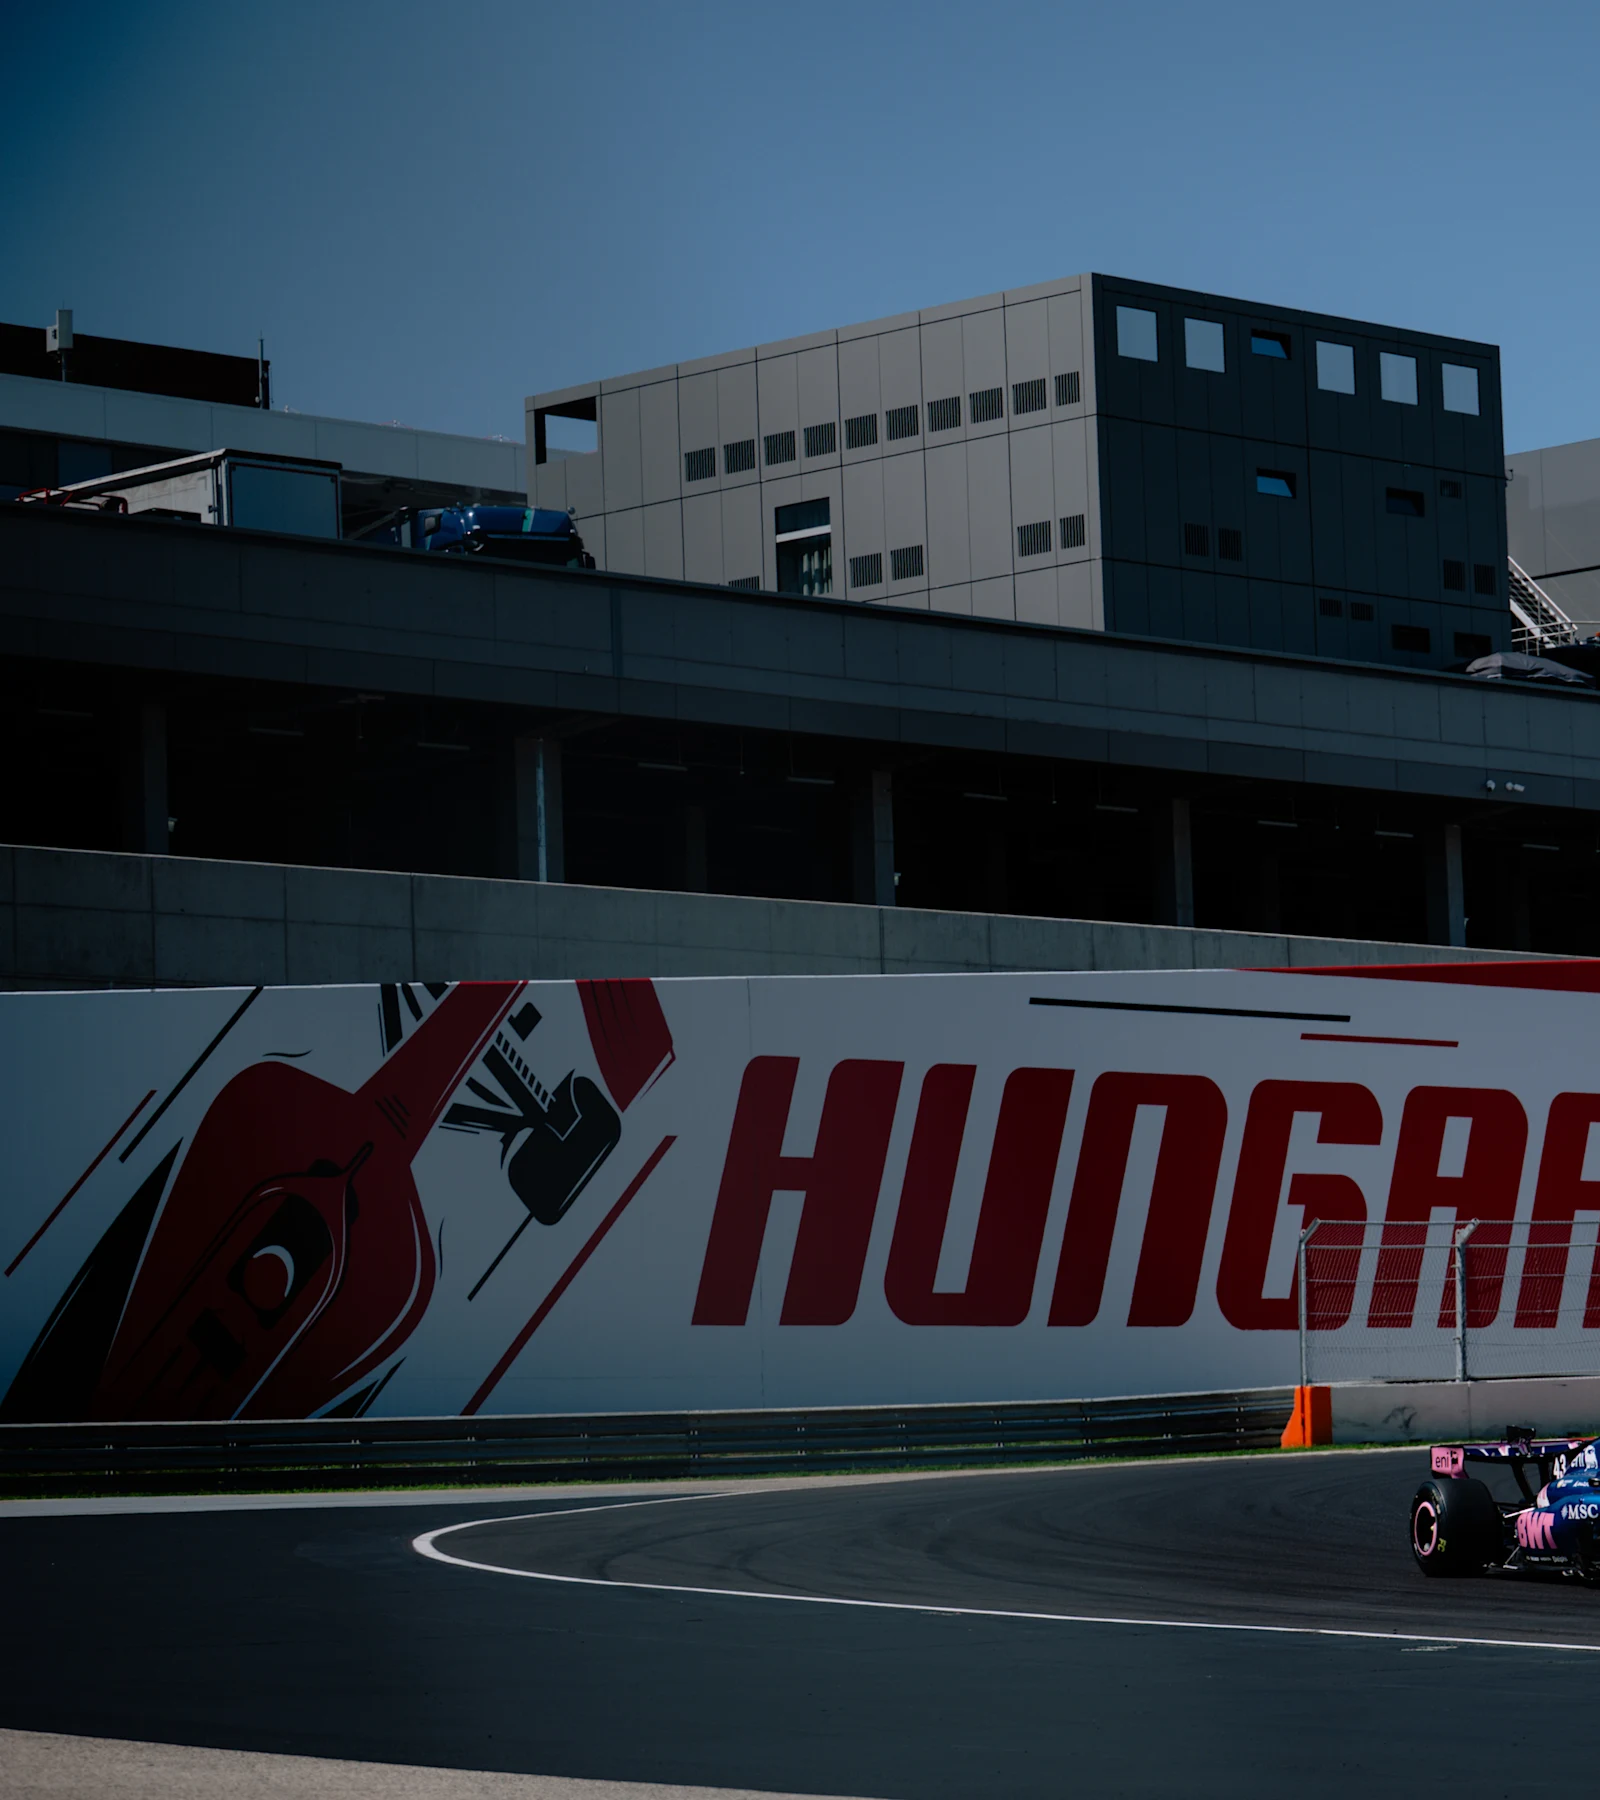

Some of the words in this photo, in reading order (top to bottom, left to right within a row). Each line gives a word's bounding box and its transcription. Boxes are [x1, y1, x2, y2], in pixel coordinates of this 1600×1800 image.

[1553, 1453, 1567, 1480] 43
[1567, 1503, 1599, 1520] MSC
[1517, 1511, 1558, 1549] BWT
